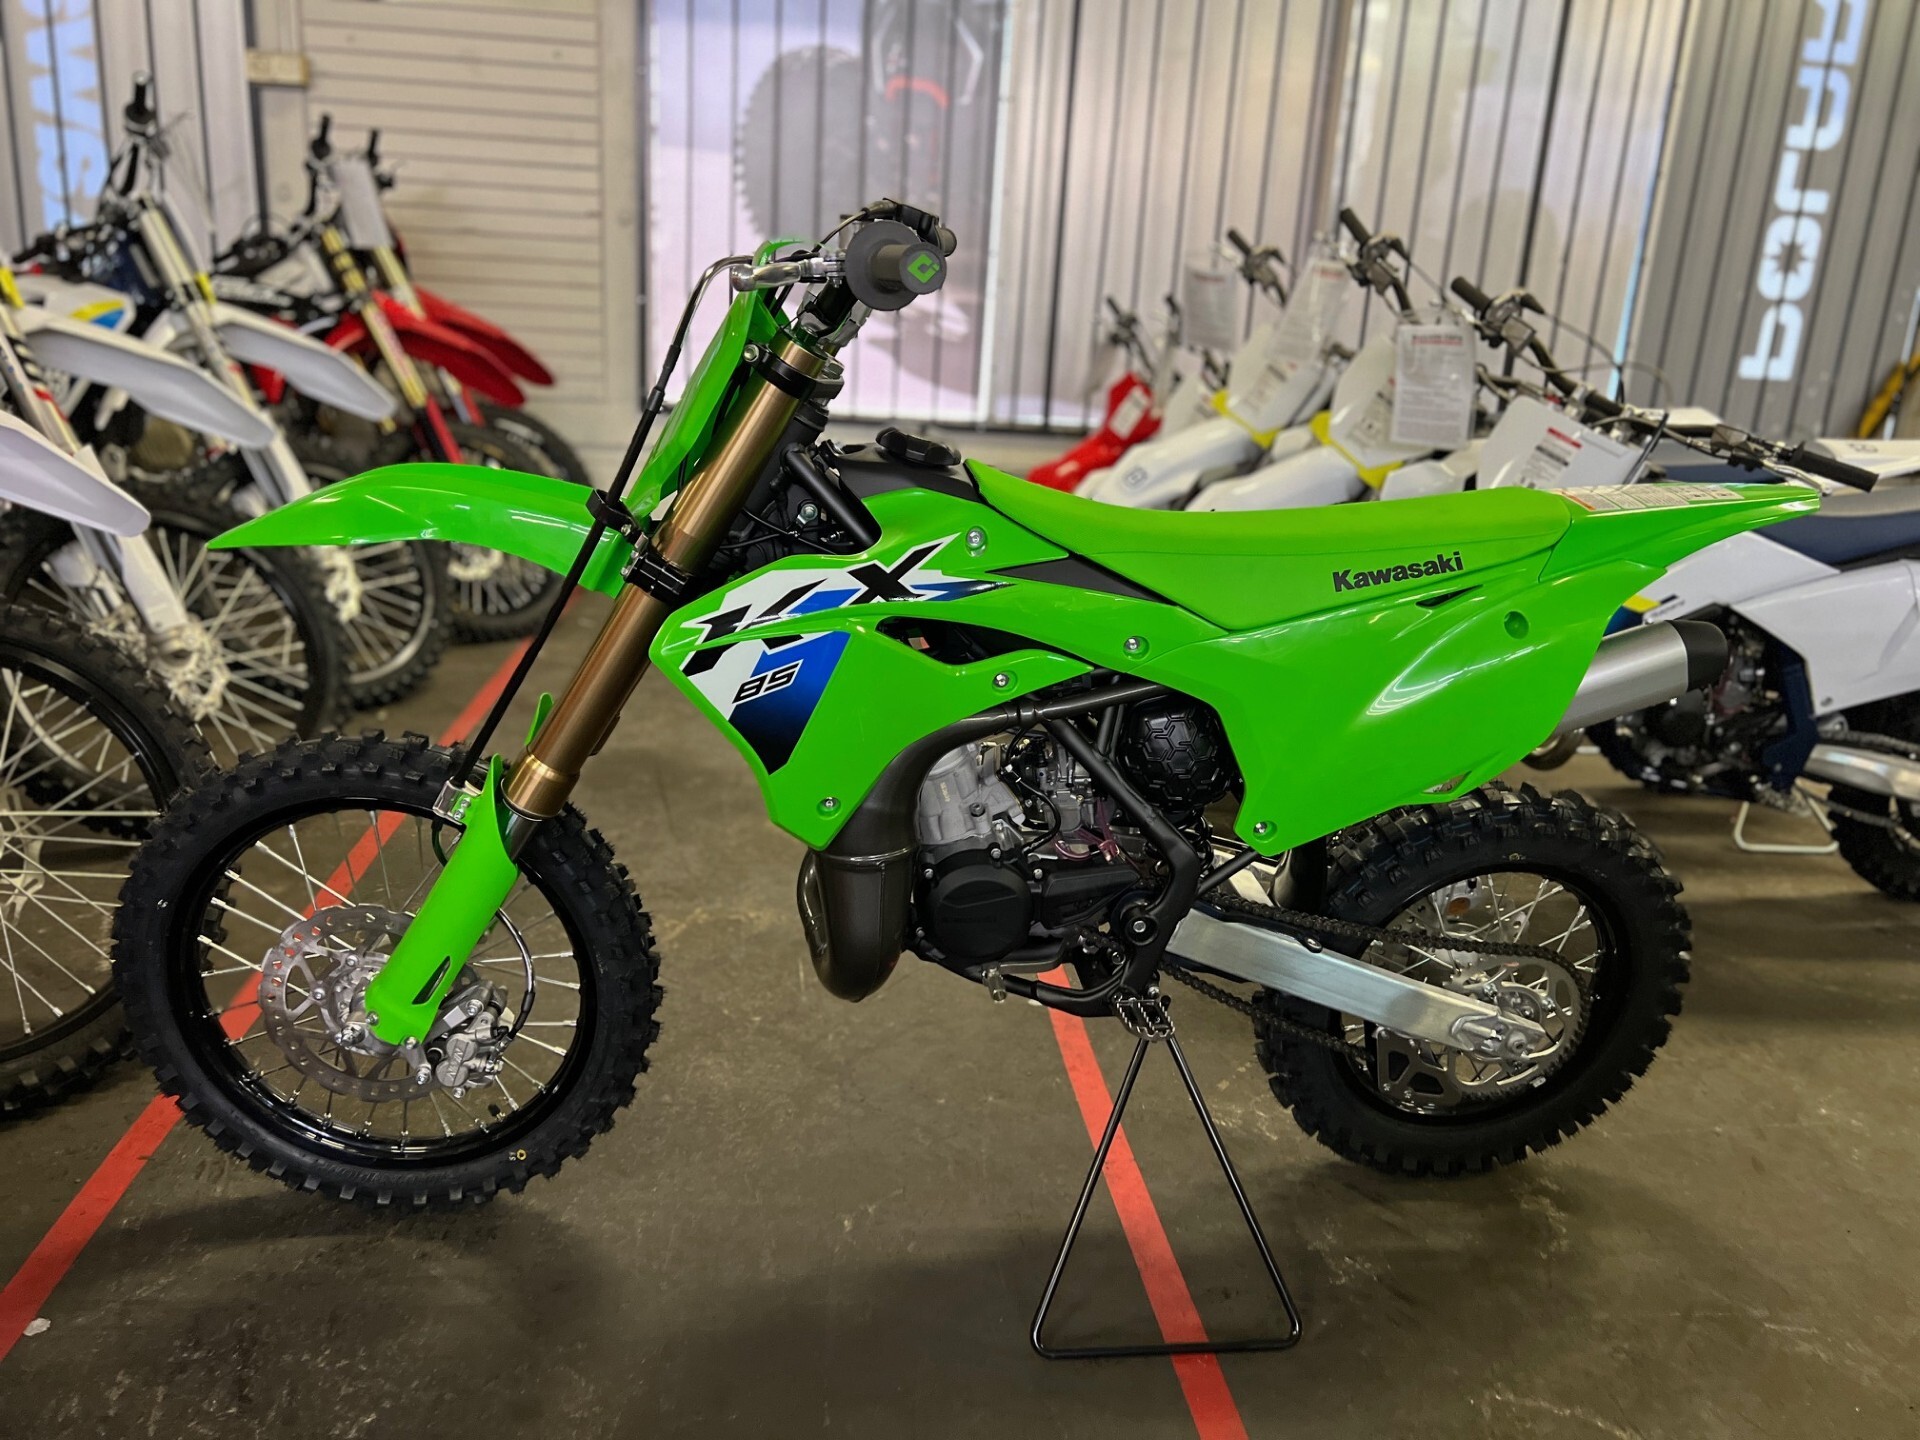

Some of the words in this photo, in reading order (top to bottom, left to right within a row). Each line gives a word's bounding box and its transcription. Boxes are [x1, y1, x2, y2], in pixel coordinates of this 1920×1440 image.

[1332, 551, 1464, 592] Kawasaki
[682, 541, 945, 677] KX
[734, 663, 802, 703] 85
